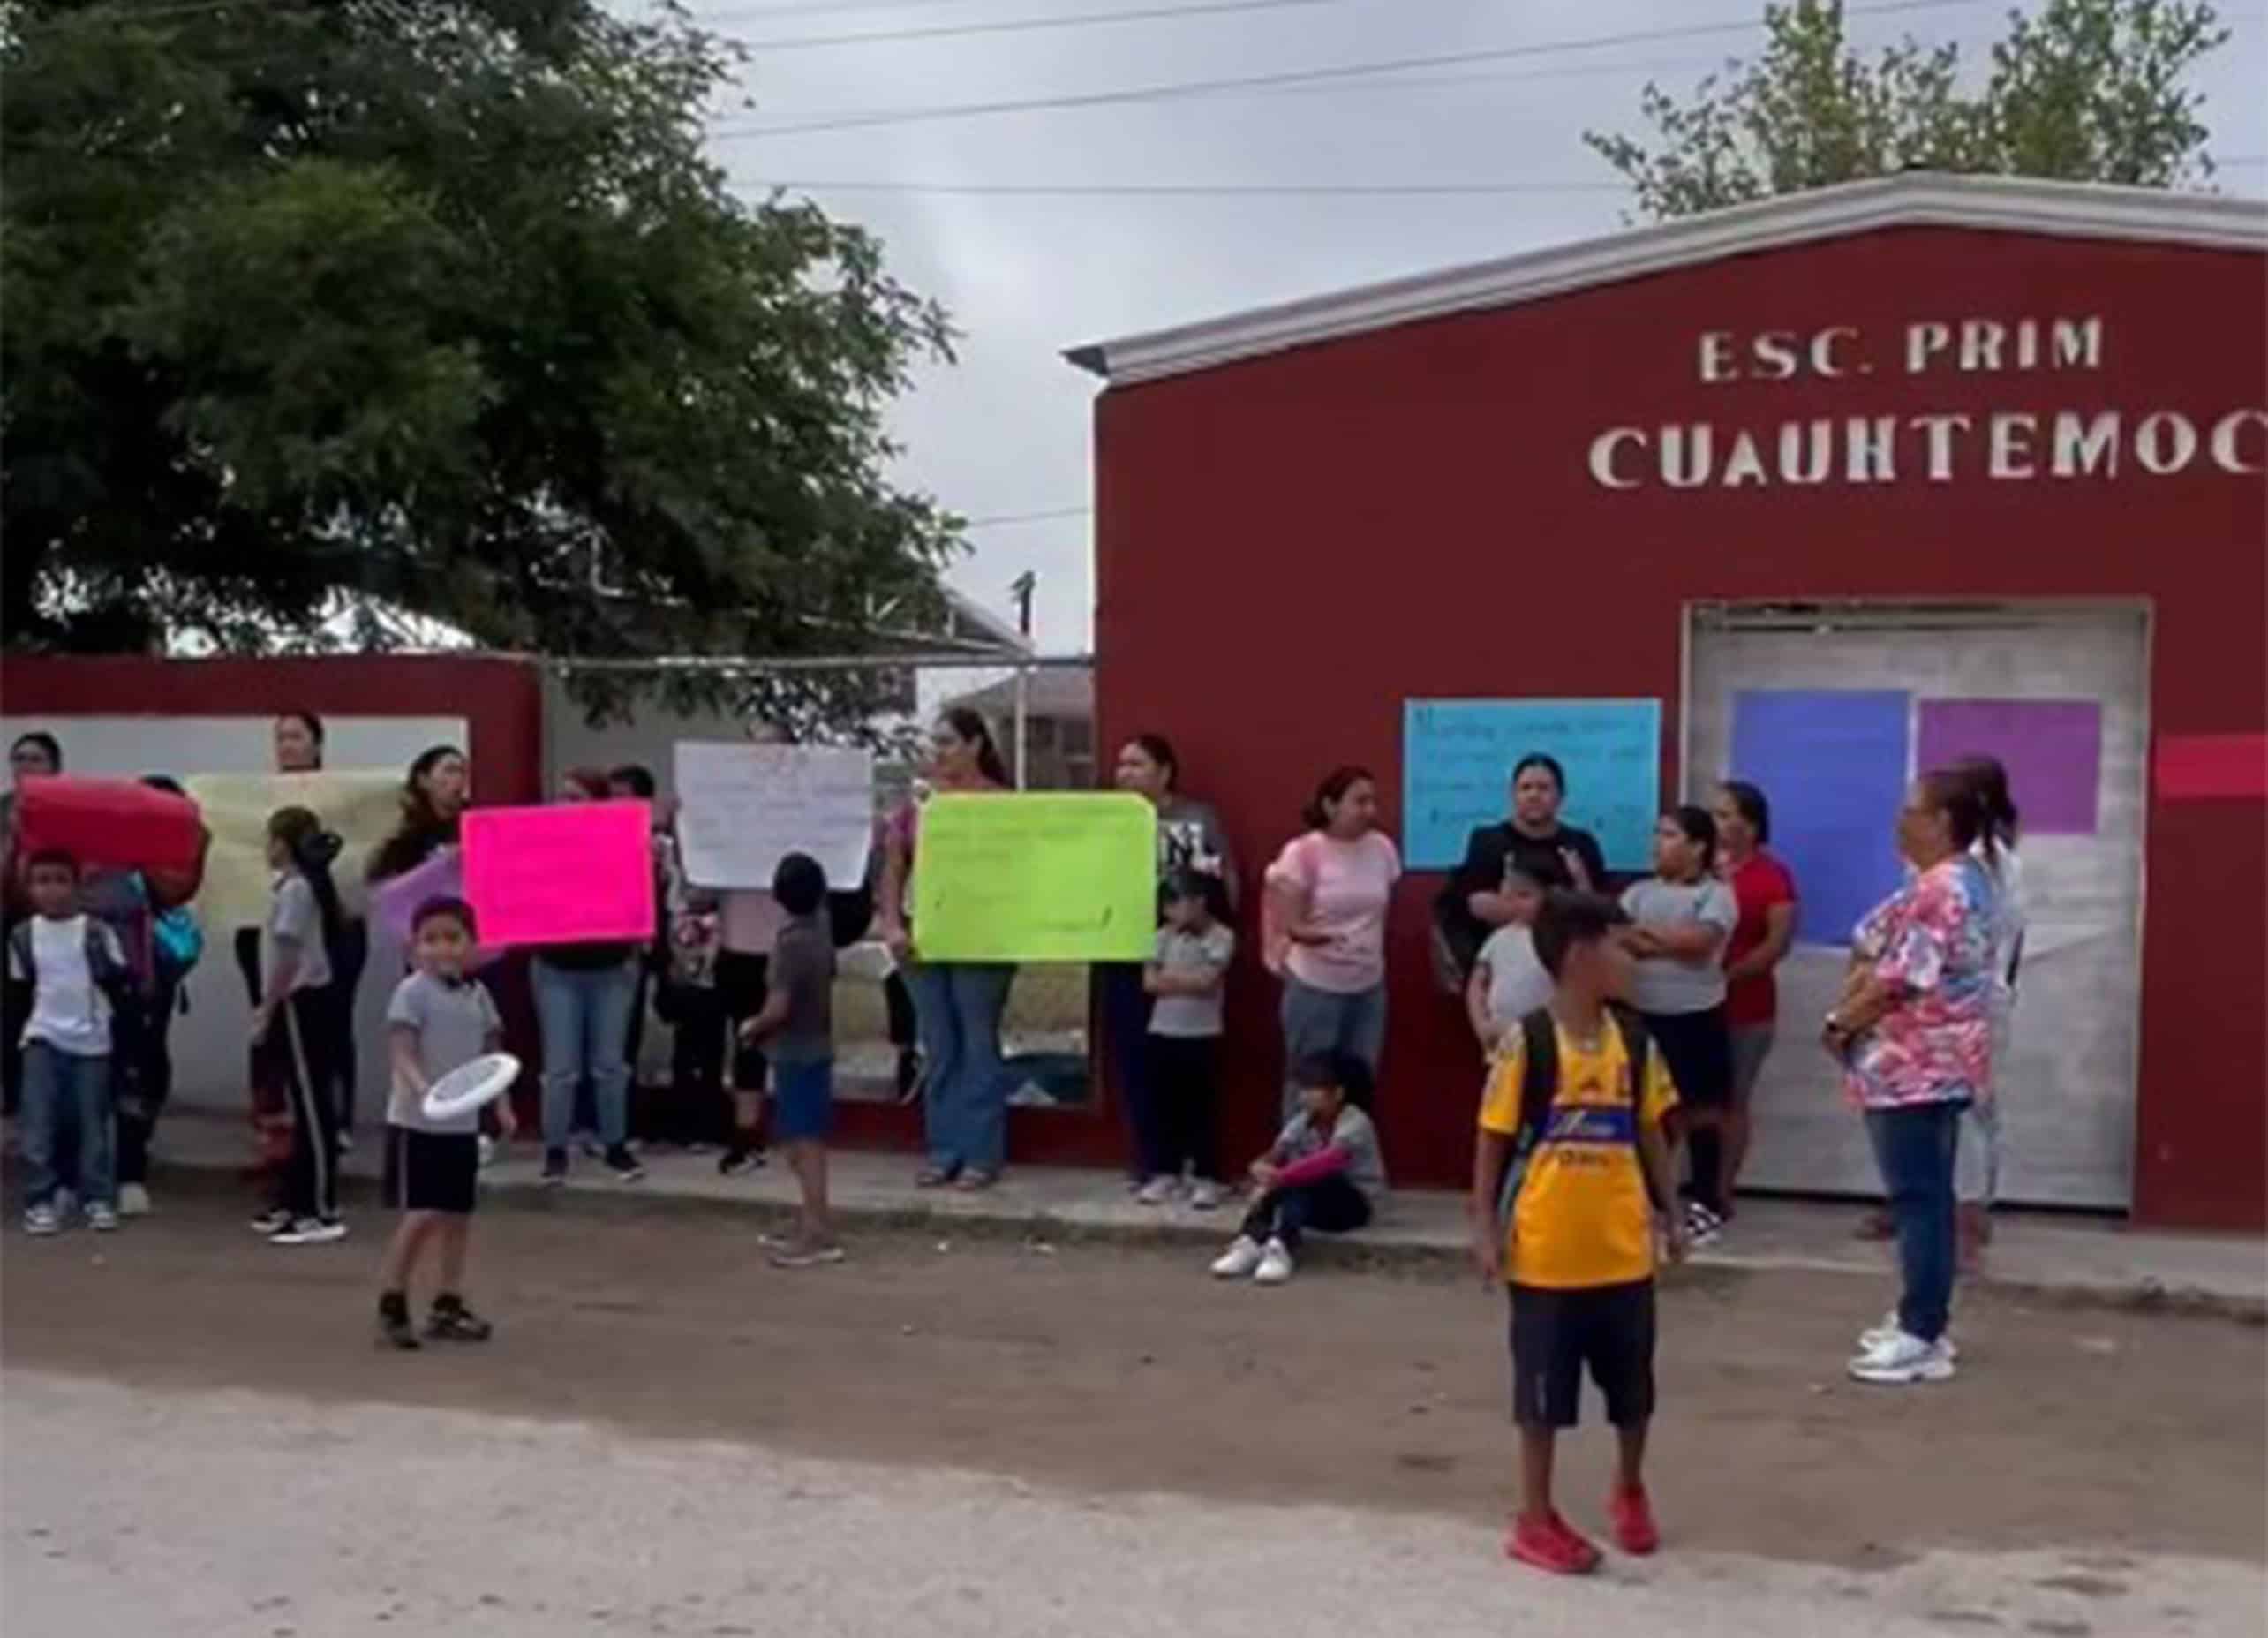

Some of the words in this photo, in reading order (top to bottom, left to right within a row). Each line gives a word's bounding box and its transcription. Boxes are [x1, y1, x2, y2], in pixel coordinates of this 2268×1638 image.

[1699, 327, 1872, 382] ESC.
[1906, 317, 2103, 373] PRIM
[1588, 409, 2268, 489] CUAUHTEMOC
